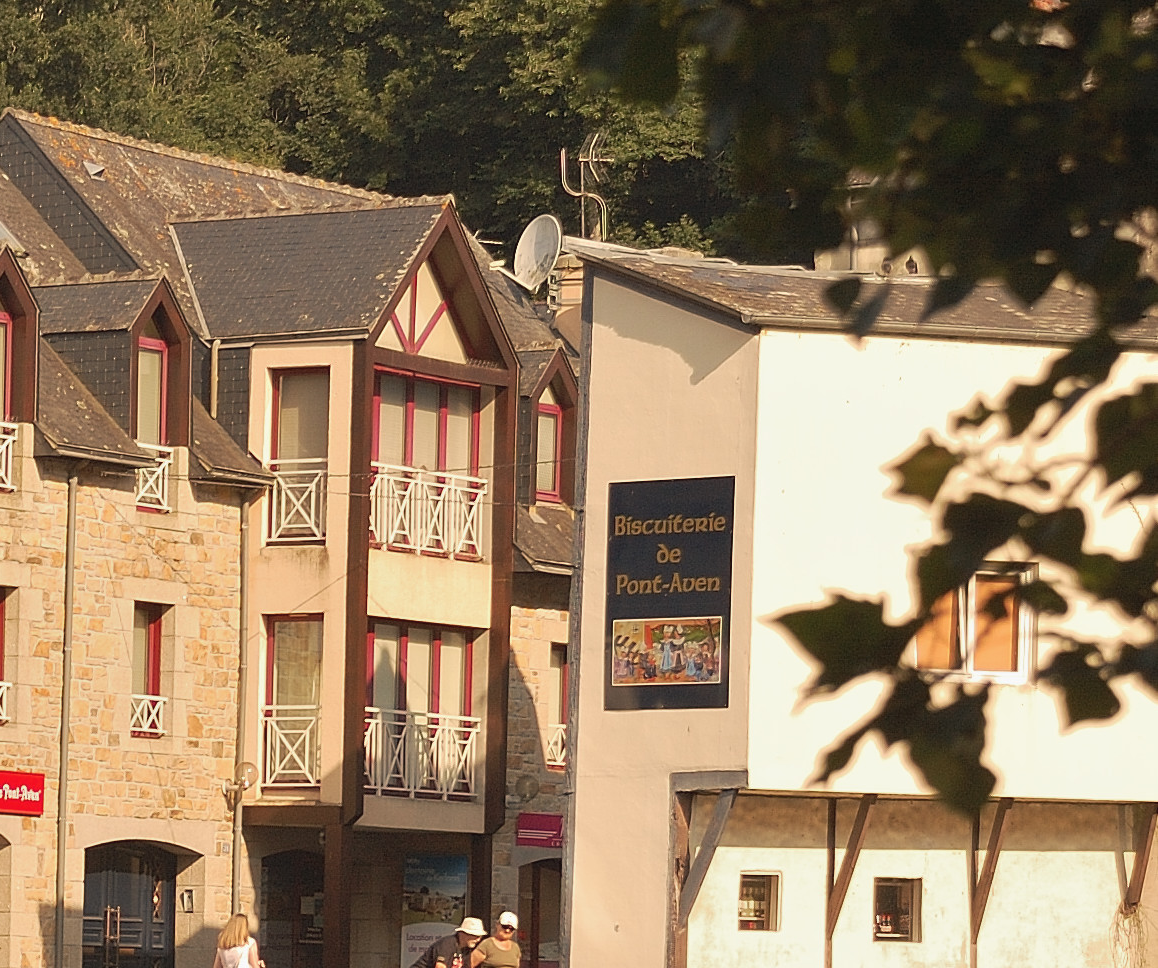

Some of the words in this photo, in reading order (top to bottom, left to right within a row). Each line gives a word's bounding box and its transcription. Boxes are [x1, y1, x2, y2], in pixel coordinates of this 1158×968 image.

[614, 513, 726, 536] Biscuiterie
[656, 544, 681, 564] de
[615, 573, 720, 595] Pont-Aven
